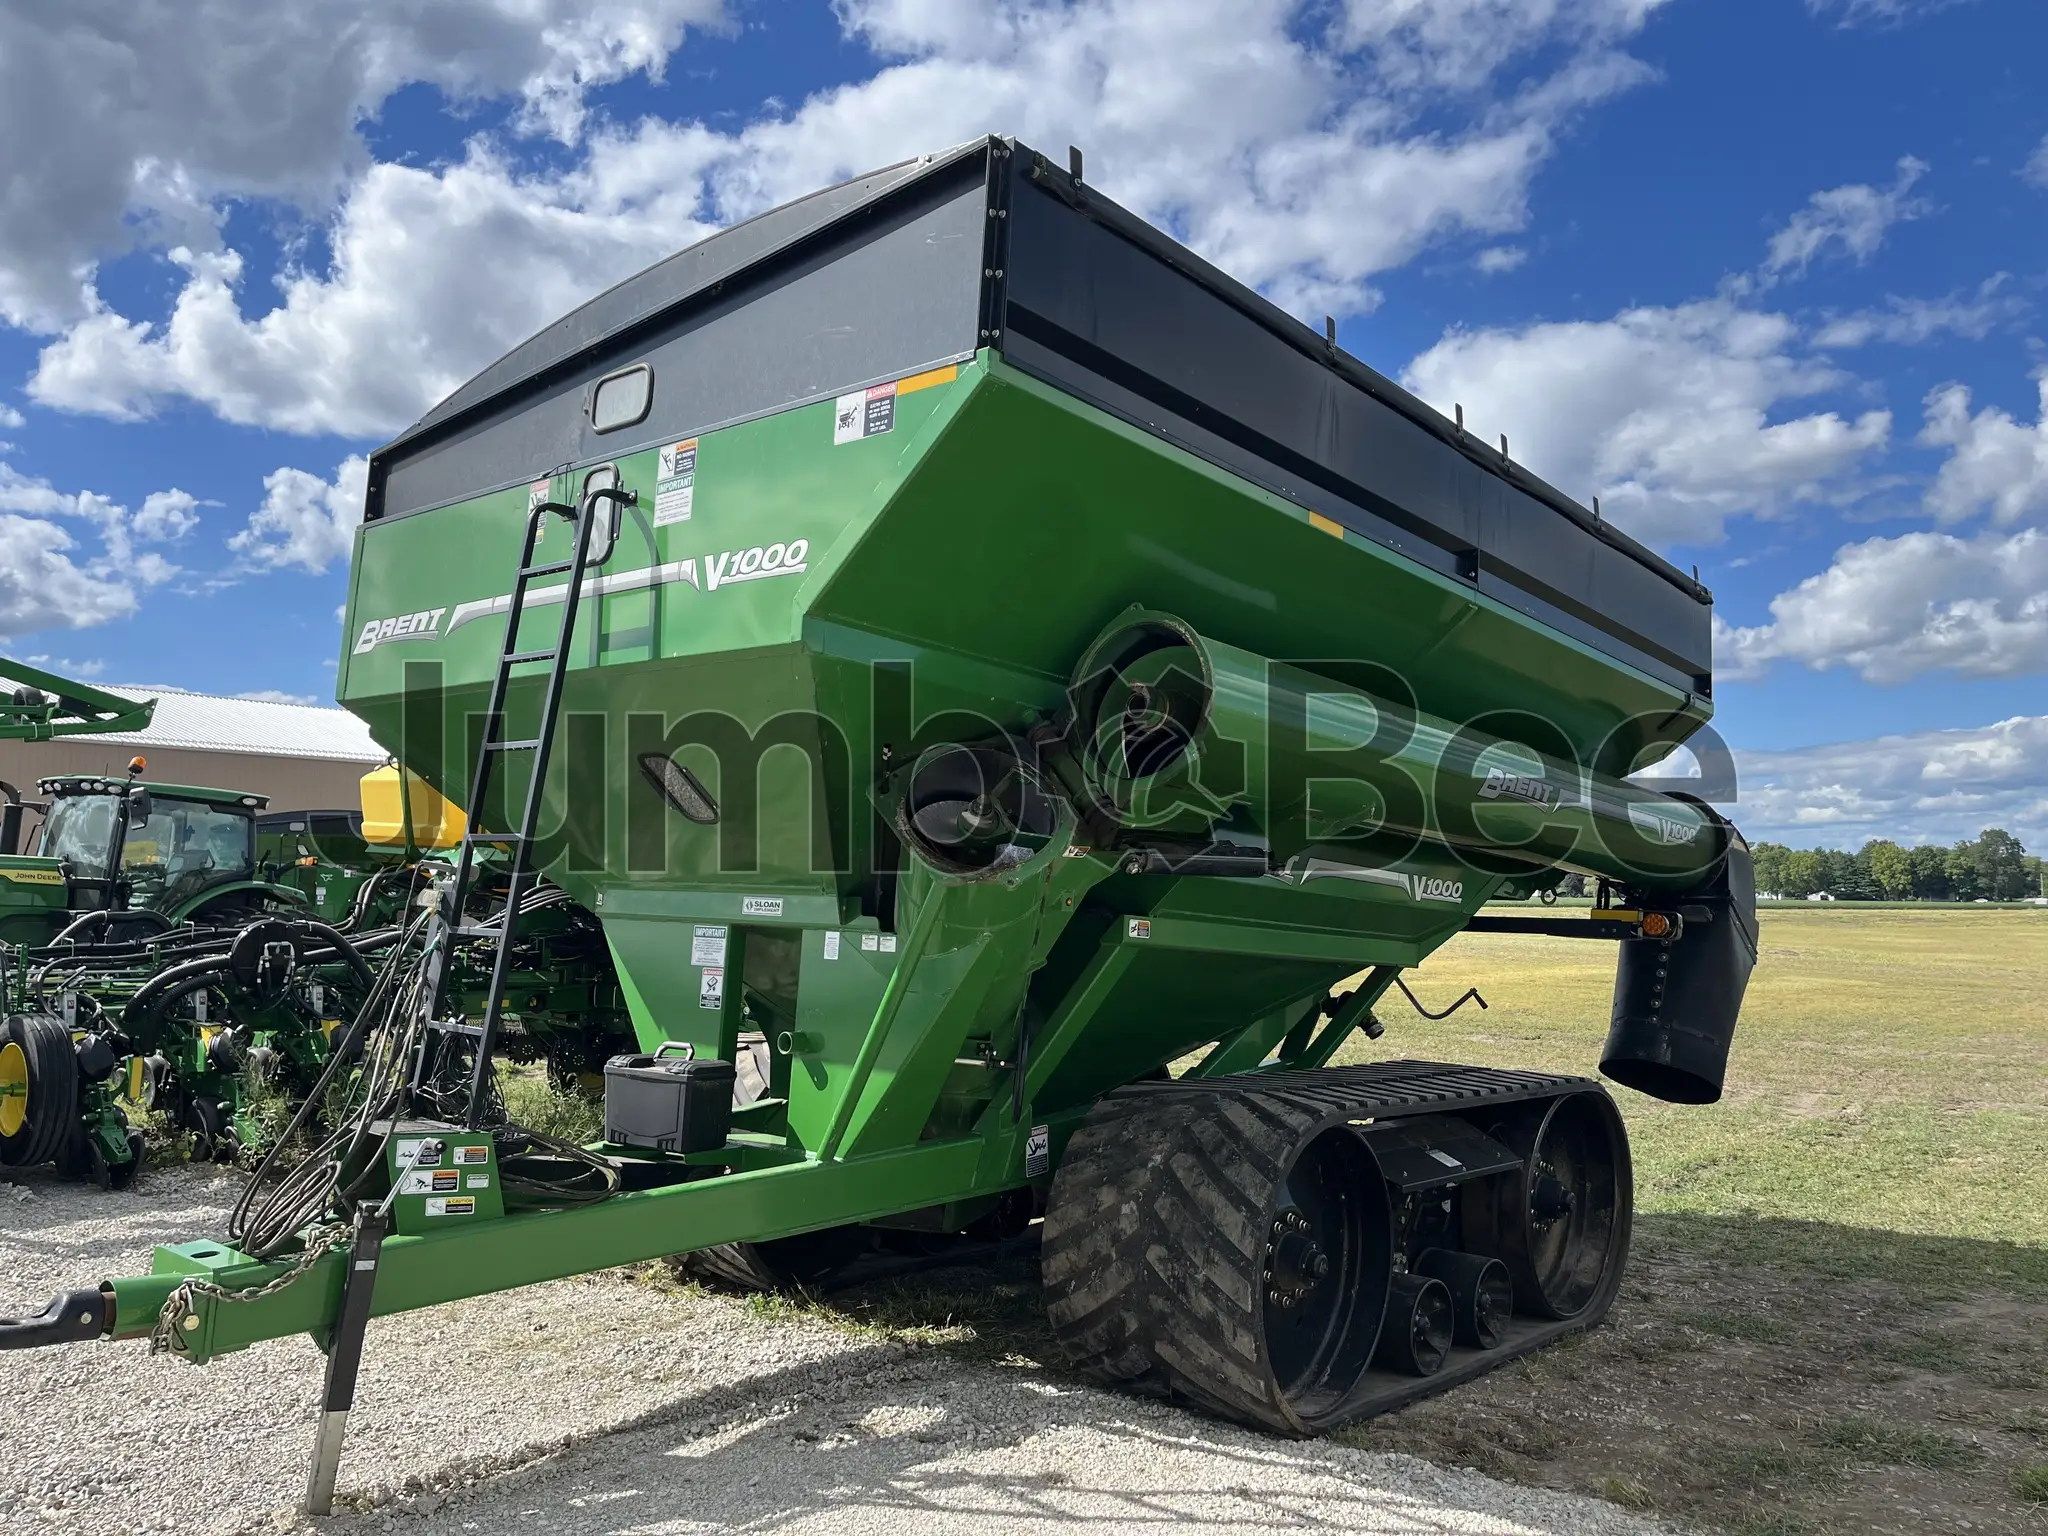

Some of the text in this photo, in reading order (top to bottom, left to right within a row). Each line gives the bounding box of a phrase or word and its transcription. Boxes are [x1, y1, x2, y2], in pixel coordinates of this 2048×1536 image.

[872, 384, 896, 398] DANGER
[658, 476, 692, 494] IMPORTANT
[704, 538, 809, 592] V1000
[353, 606, 447, 655] BRENT
[1476, 767, 1554, 803] BRENT
[1412, 874, 1463, 902] V1000
[754, 900, 781, 909] SLOAN
[695, 927, 726, 938] IMPORTANT
